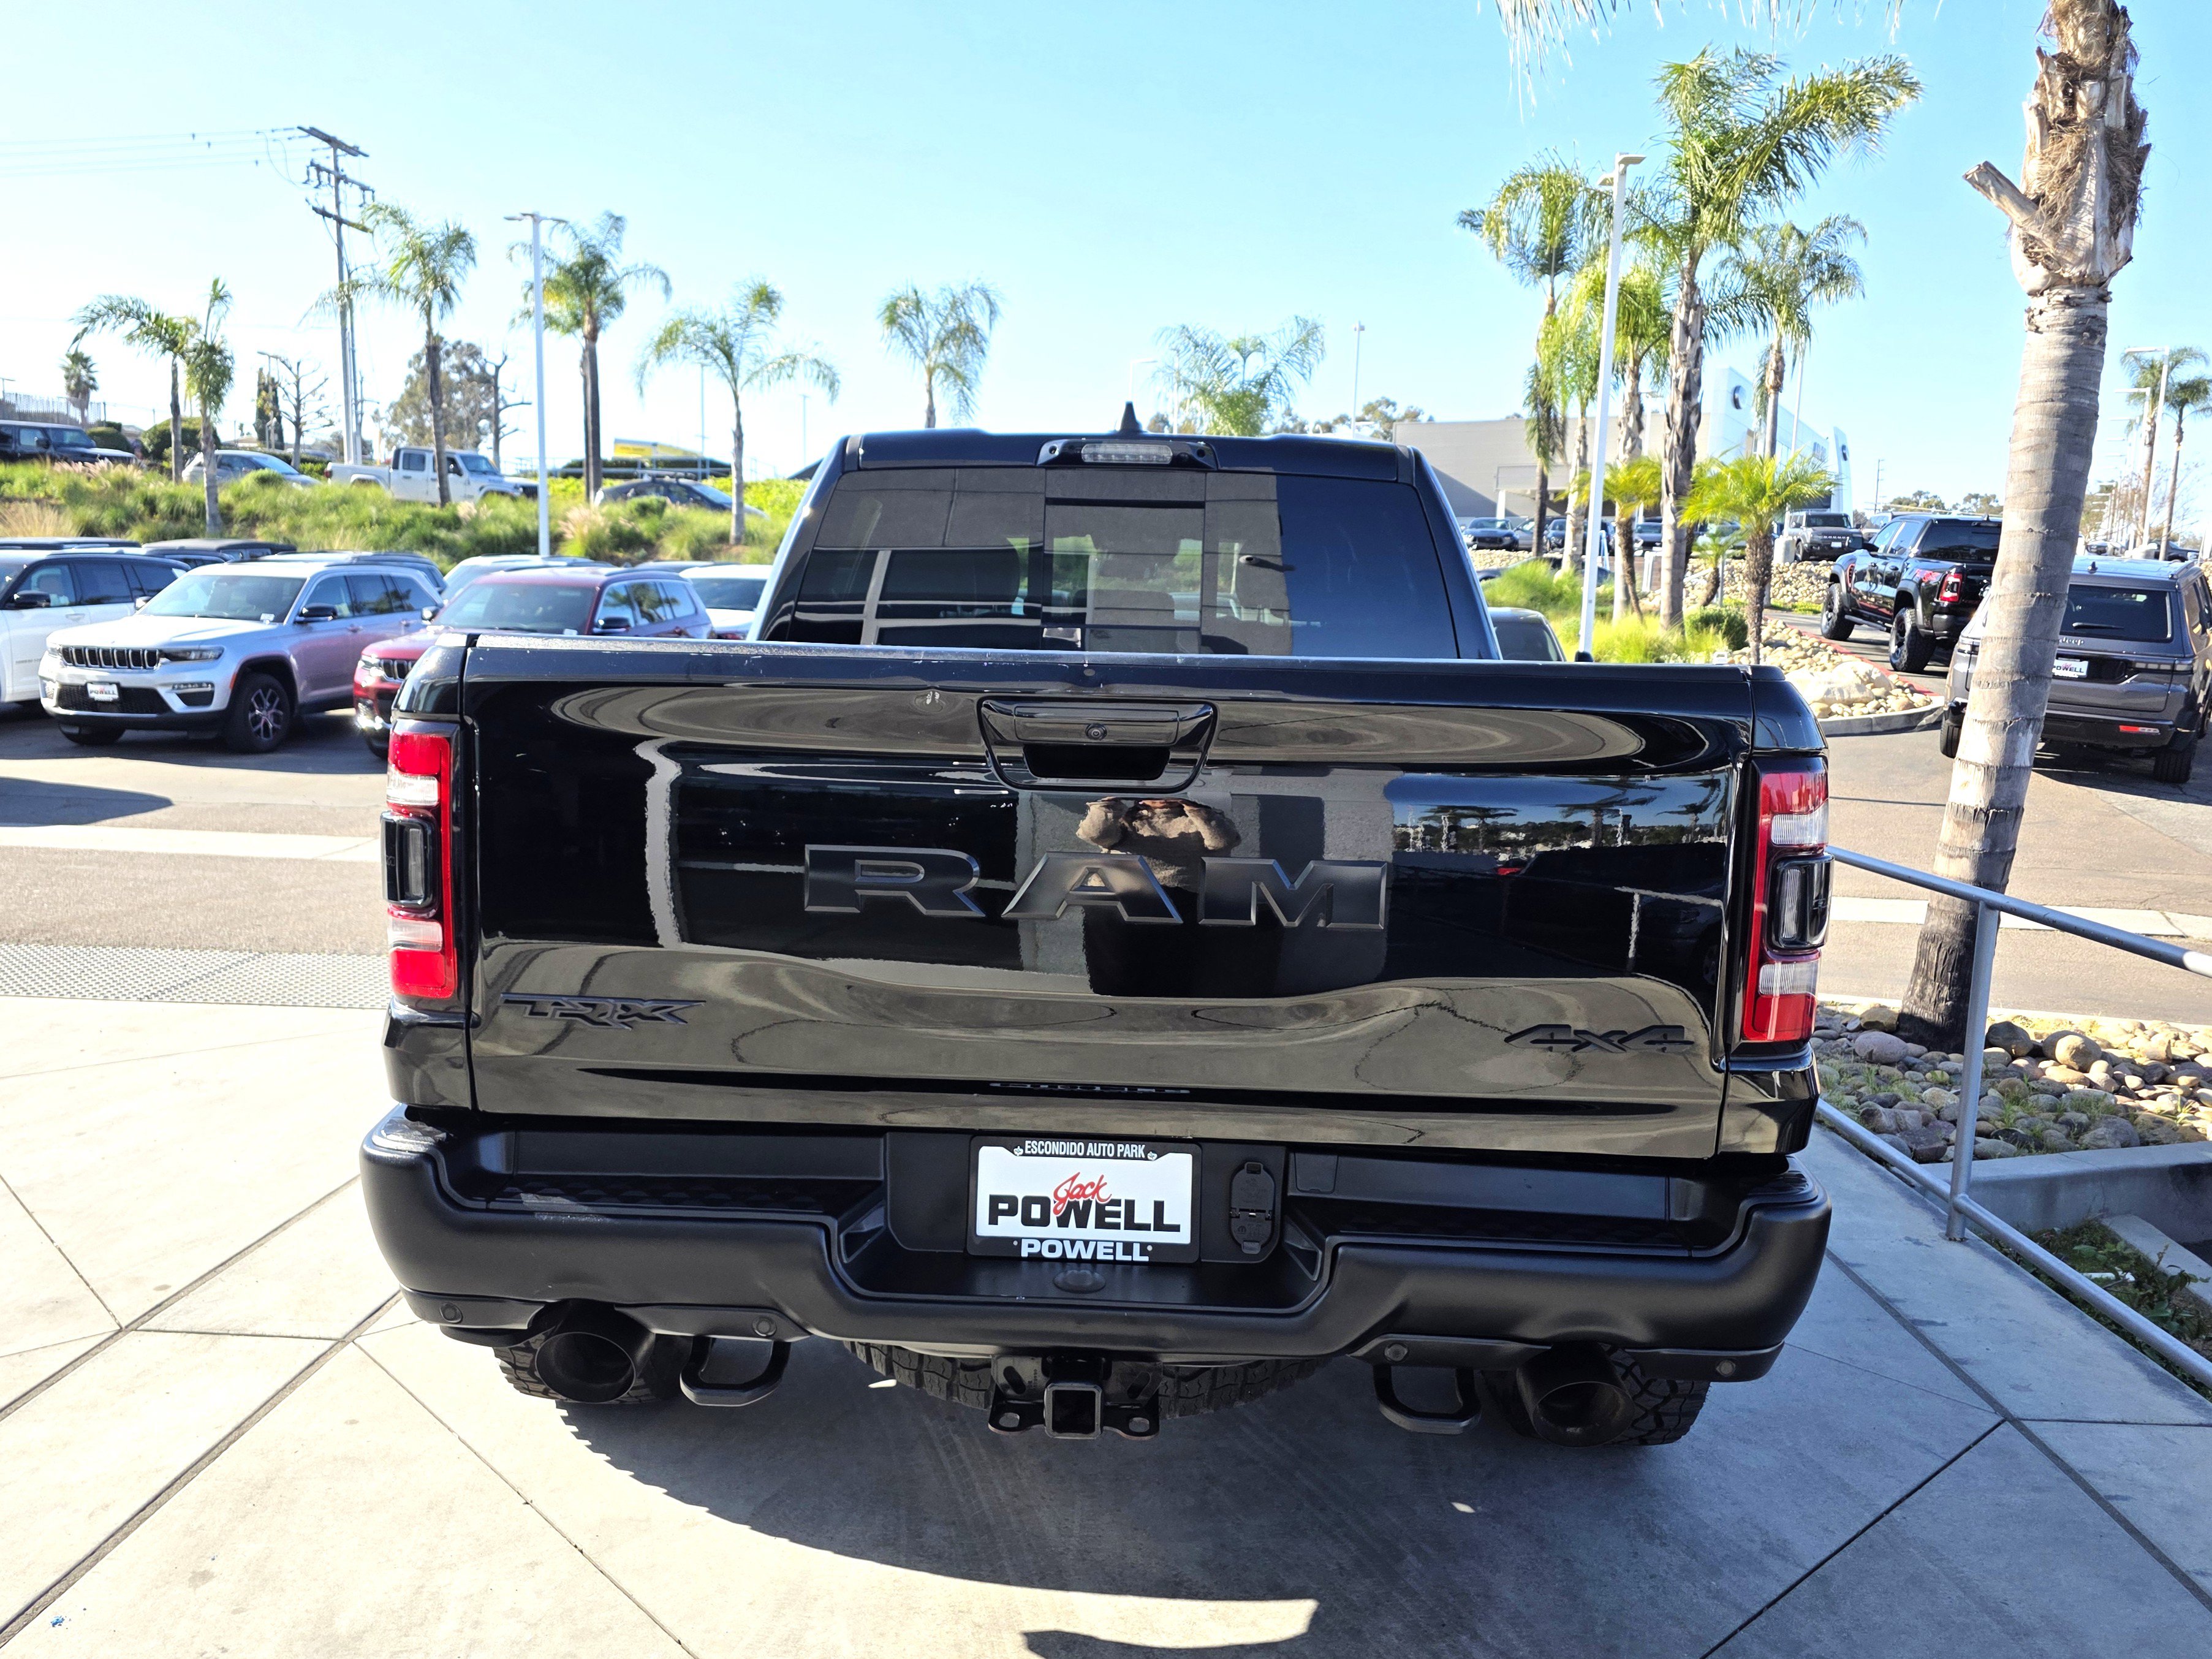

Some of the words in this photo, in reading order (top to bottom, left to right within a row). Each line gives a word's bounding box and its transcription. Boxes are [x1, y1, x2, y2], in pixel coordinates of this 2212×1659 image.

[805, 844, 1387, 929] RAM
[500, 992, 706, 1031] TRX
[1025, 1140, 1085, 1156] ESCONDIDO
[1086, 1142, 1115, 1157] AUTO
[1117, 1144, 1146, 1158] PARK
[988, 1194, 1181, 1232] POWELL
[1053, 1172, 1112, 1217] Jack
[1020, 1238, 1150, 1262] POWELL
